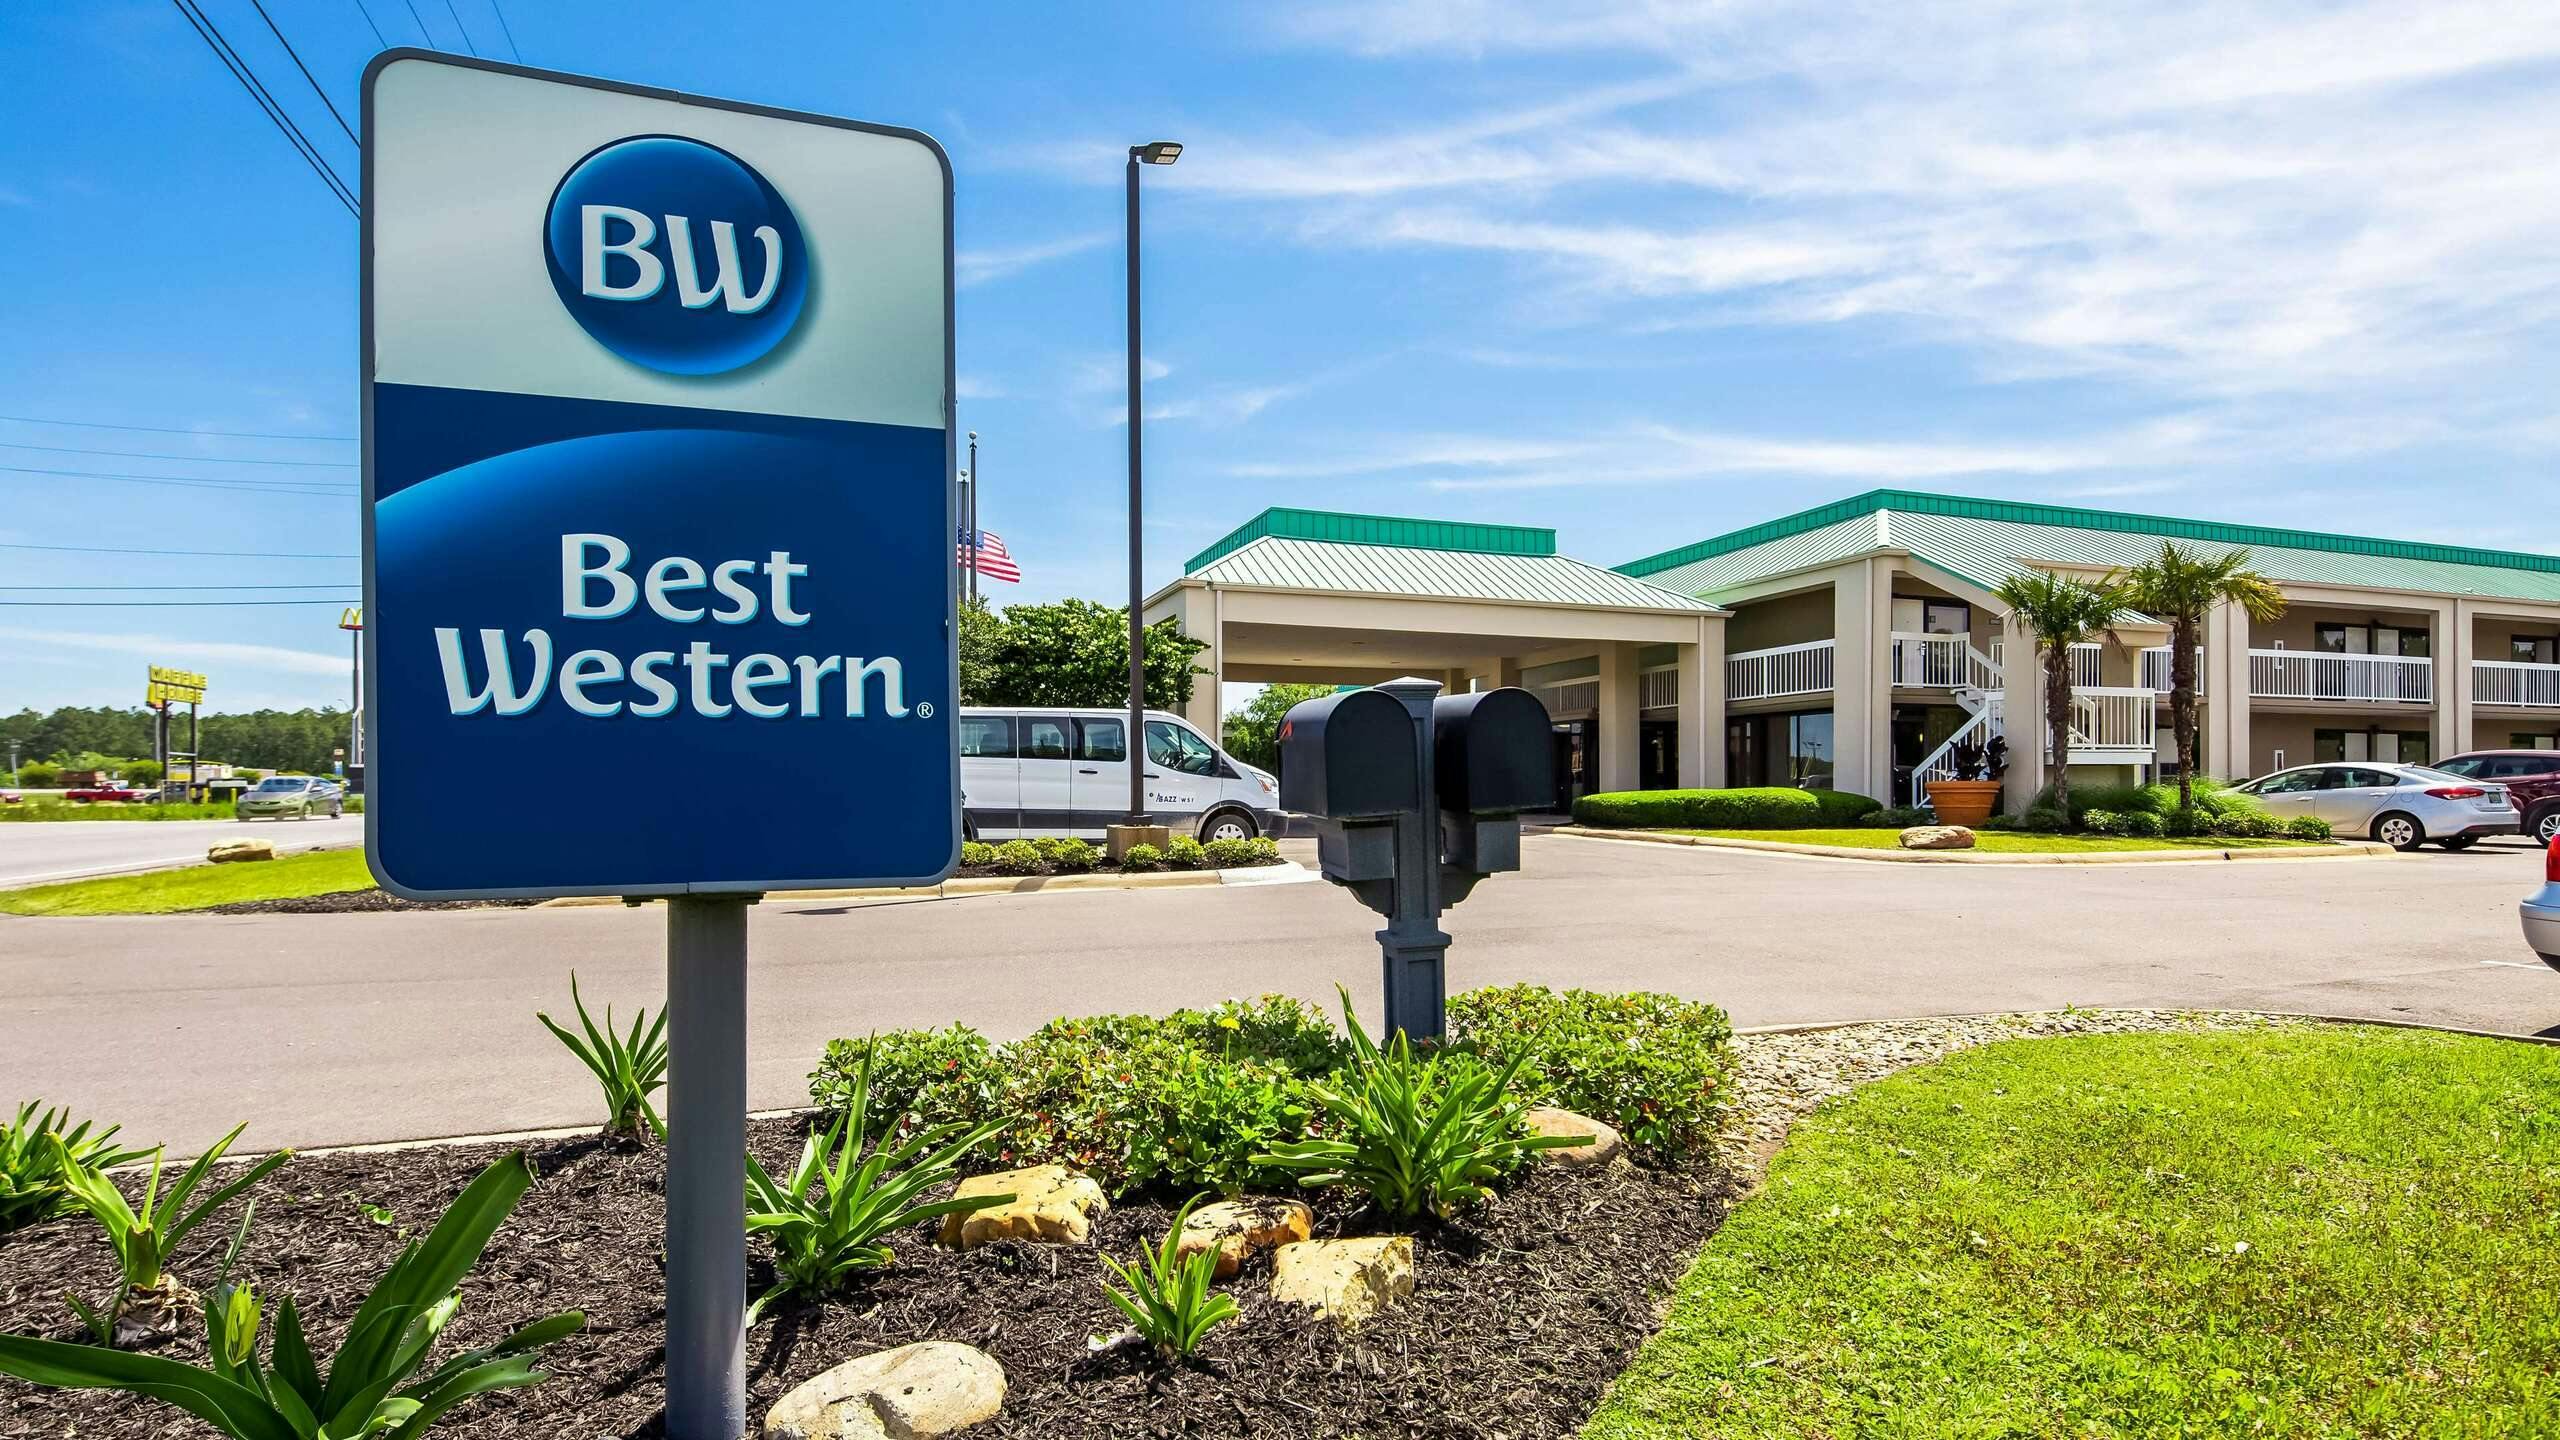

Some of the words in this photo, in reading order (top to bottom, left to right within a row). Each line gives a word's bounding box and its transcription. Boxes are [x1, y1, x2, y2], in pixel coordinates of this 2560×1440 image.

[581, 204, 784, 314] BW
[561, 533, 812, 627] Best
[434, 627, 910, 719] Western
